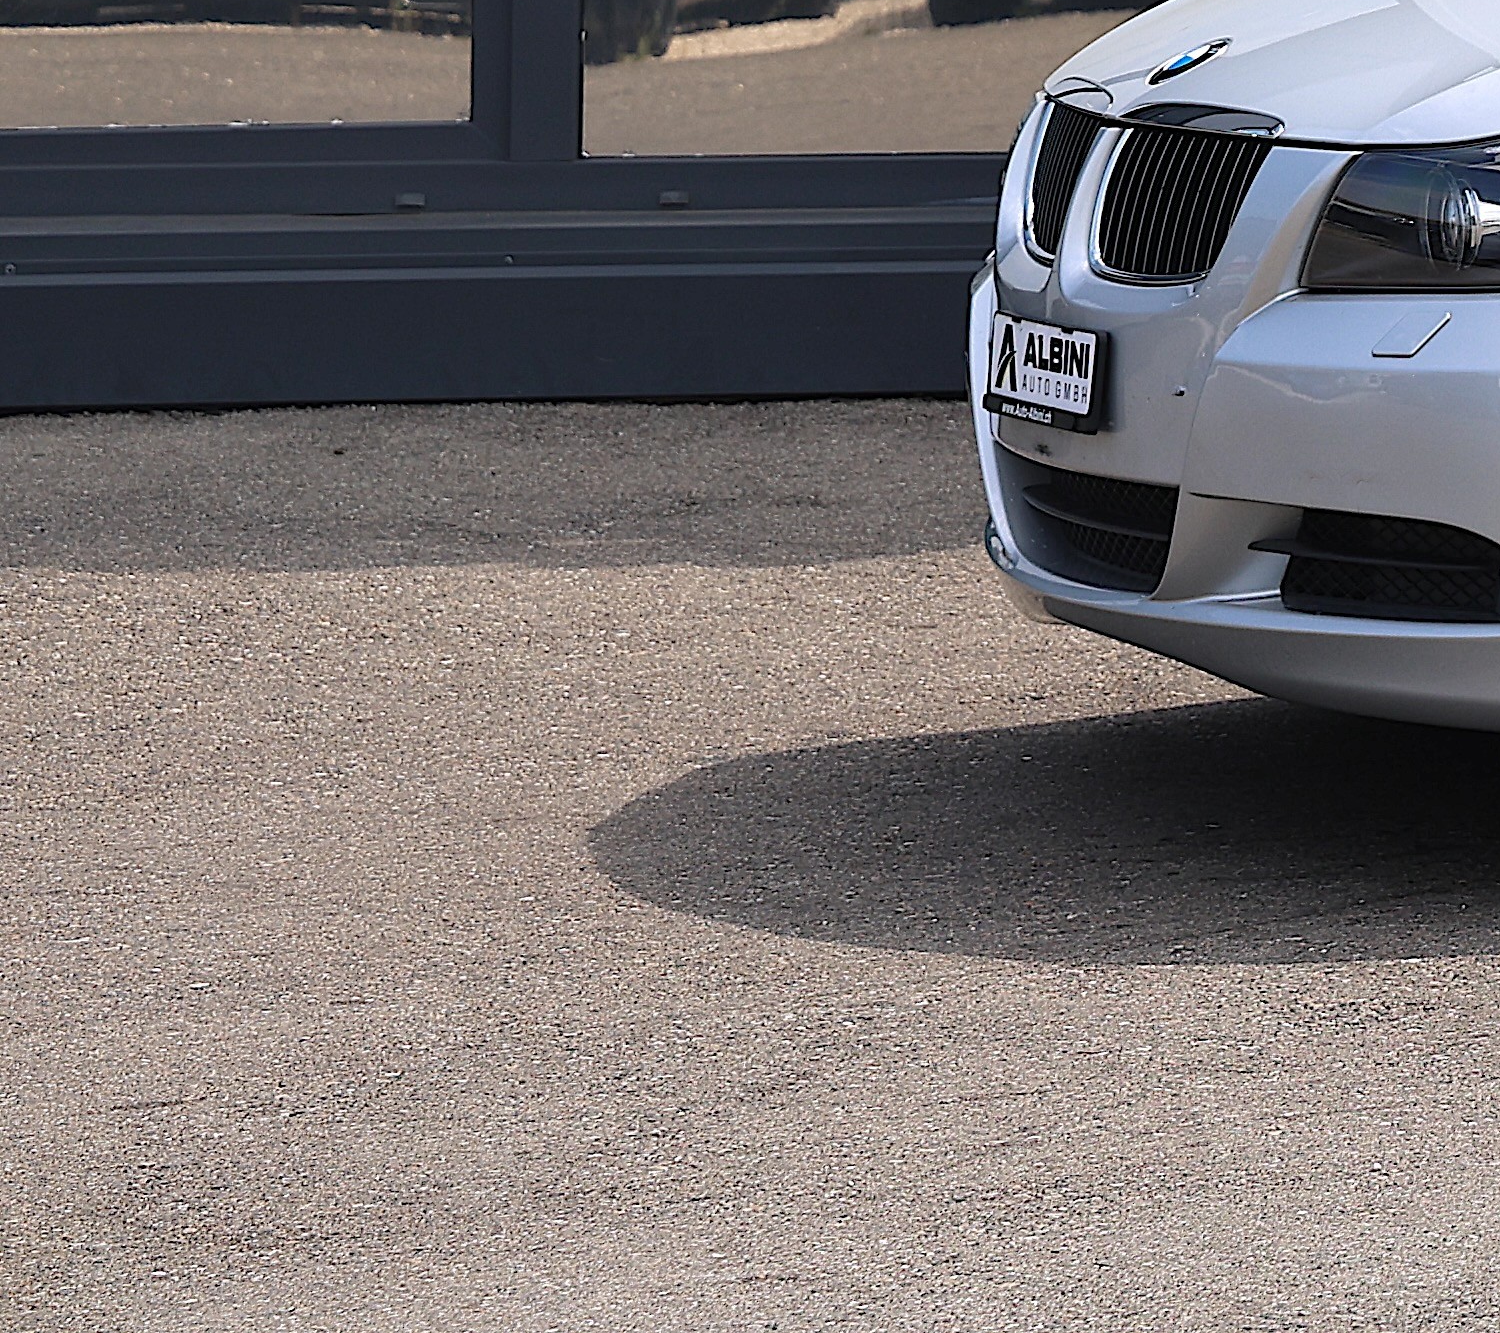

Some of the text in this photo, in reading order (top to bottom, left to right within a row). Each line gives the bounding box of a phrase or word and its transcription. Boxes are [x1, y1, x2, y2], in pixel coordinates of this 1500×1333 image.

[1022, 332, 1091, 380] ALBINI
[1022, 374, 1089, 405] AUTO GMBH
